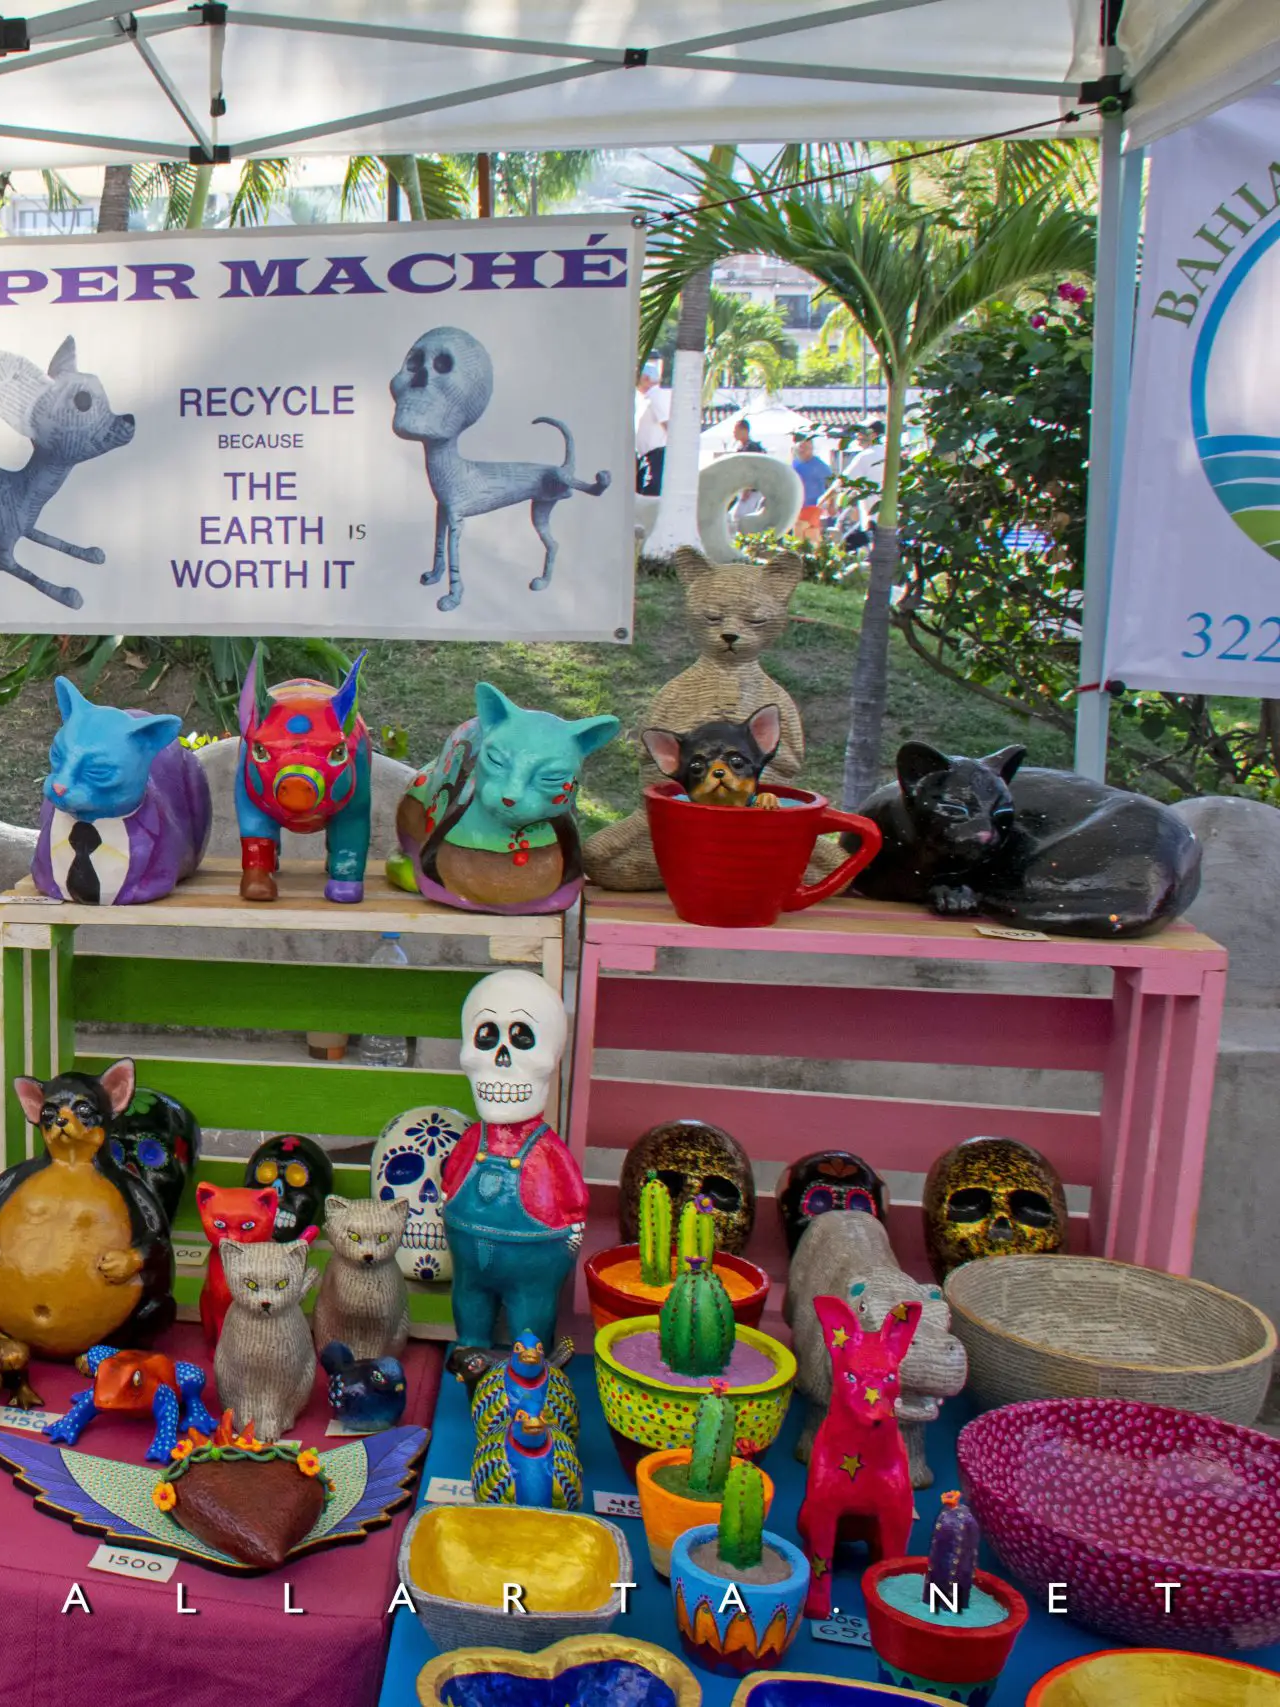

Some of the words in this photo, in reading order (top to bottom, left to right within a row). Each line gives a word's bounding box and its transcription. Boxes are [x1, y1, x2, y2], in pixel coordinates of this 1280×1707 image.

[220, 233, 628, 300] MACHÉ
[179, 385, 356, 418] RECYCLE
[217, 433, 305, 450] BECAUSE
[223, 472, 298, 502] THE
[200, 515, 325, 546] EARTH
[348, 524, 367, 541] IS
[170, 559, 310, 590] WORTH
[323, 559, 356, 590] IT
[1181, 611, 1280, 663] 322
[3, 1414, 49, 1429] 450
[108, 1553, 162, 1572] 1500
